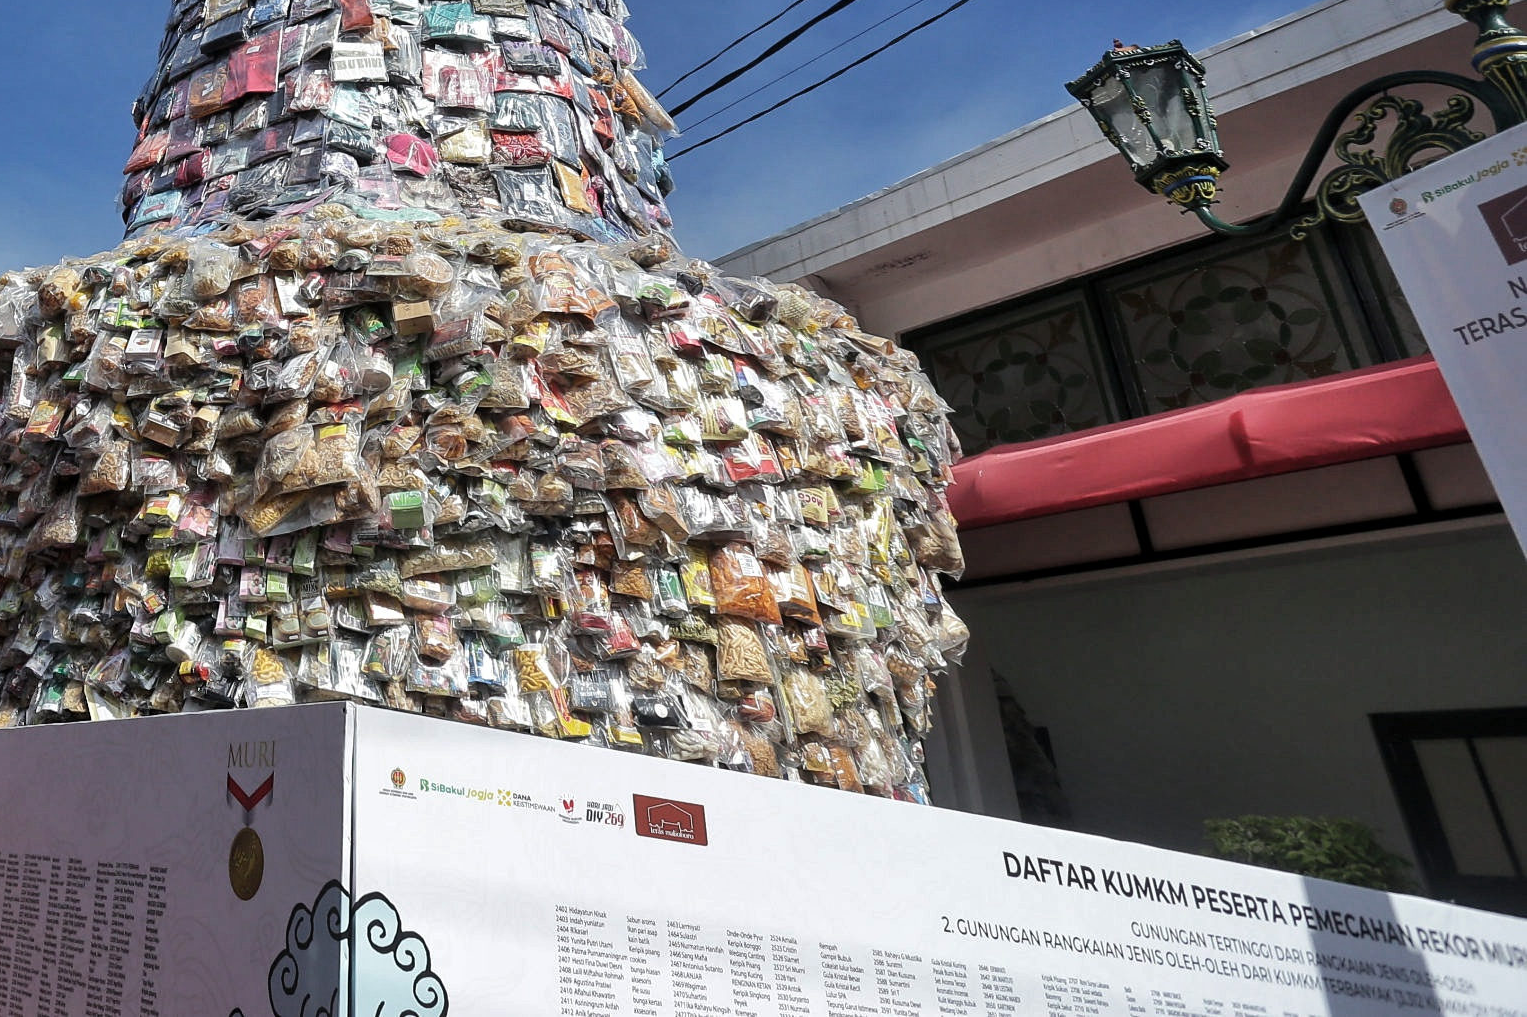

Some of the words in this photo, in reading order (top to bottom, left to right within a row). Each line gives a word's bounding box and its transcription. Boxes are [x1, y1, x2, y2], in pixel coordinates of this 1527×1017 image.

[227, 741, 276, 768] MURI
[431, 782, 465, 796] SiBakul
[513, 793, 531, 802] DANA
[586, 809, 604, 822] DIY
[604, 812, 624, 827] 269
[1002, 851, 1099, 892] DAFTAR
[1101, 868, 1190, 908] KUMKM
[1191, 885, 1288, 926] PESERTA
[1289, 902, 1415, 948] PEMECAHAN
[1416, 927, 1484, 961] REKOR
[941, 916, 955, 933] 2.
[956, 918, 1041, 947] GUNUNGAN
[1043, 931, 1124, 960] RANGKAIAN
[1126, 945, 1164, 967] JENIS
[1165, 951, 1240, 979] OLEH-OLEH
[1243, 962, 1273, 983] DARI
[1274, 969, 1322, 992] KUMKM
[1130, 921, 1207, 948] GUNUNGAN
[1207, 934, 1274, 960] TERTINGGI
[1275, 945, 1305, 965] DARI
[1306, 950, 1375, 977] RANGKAIAN
